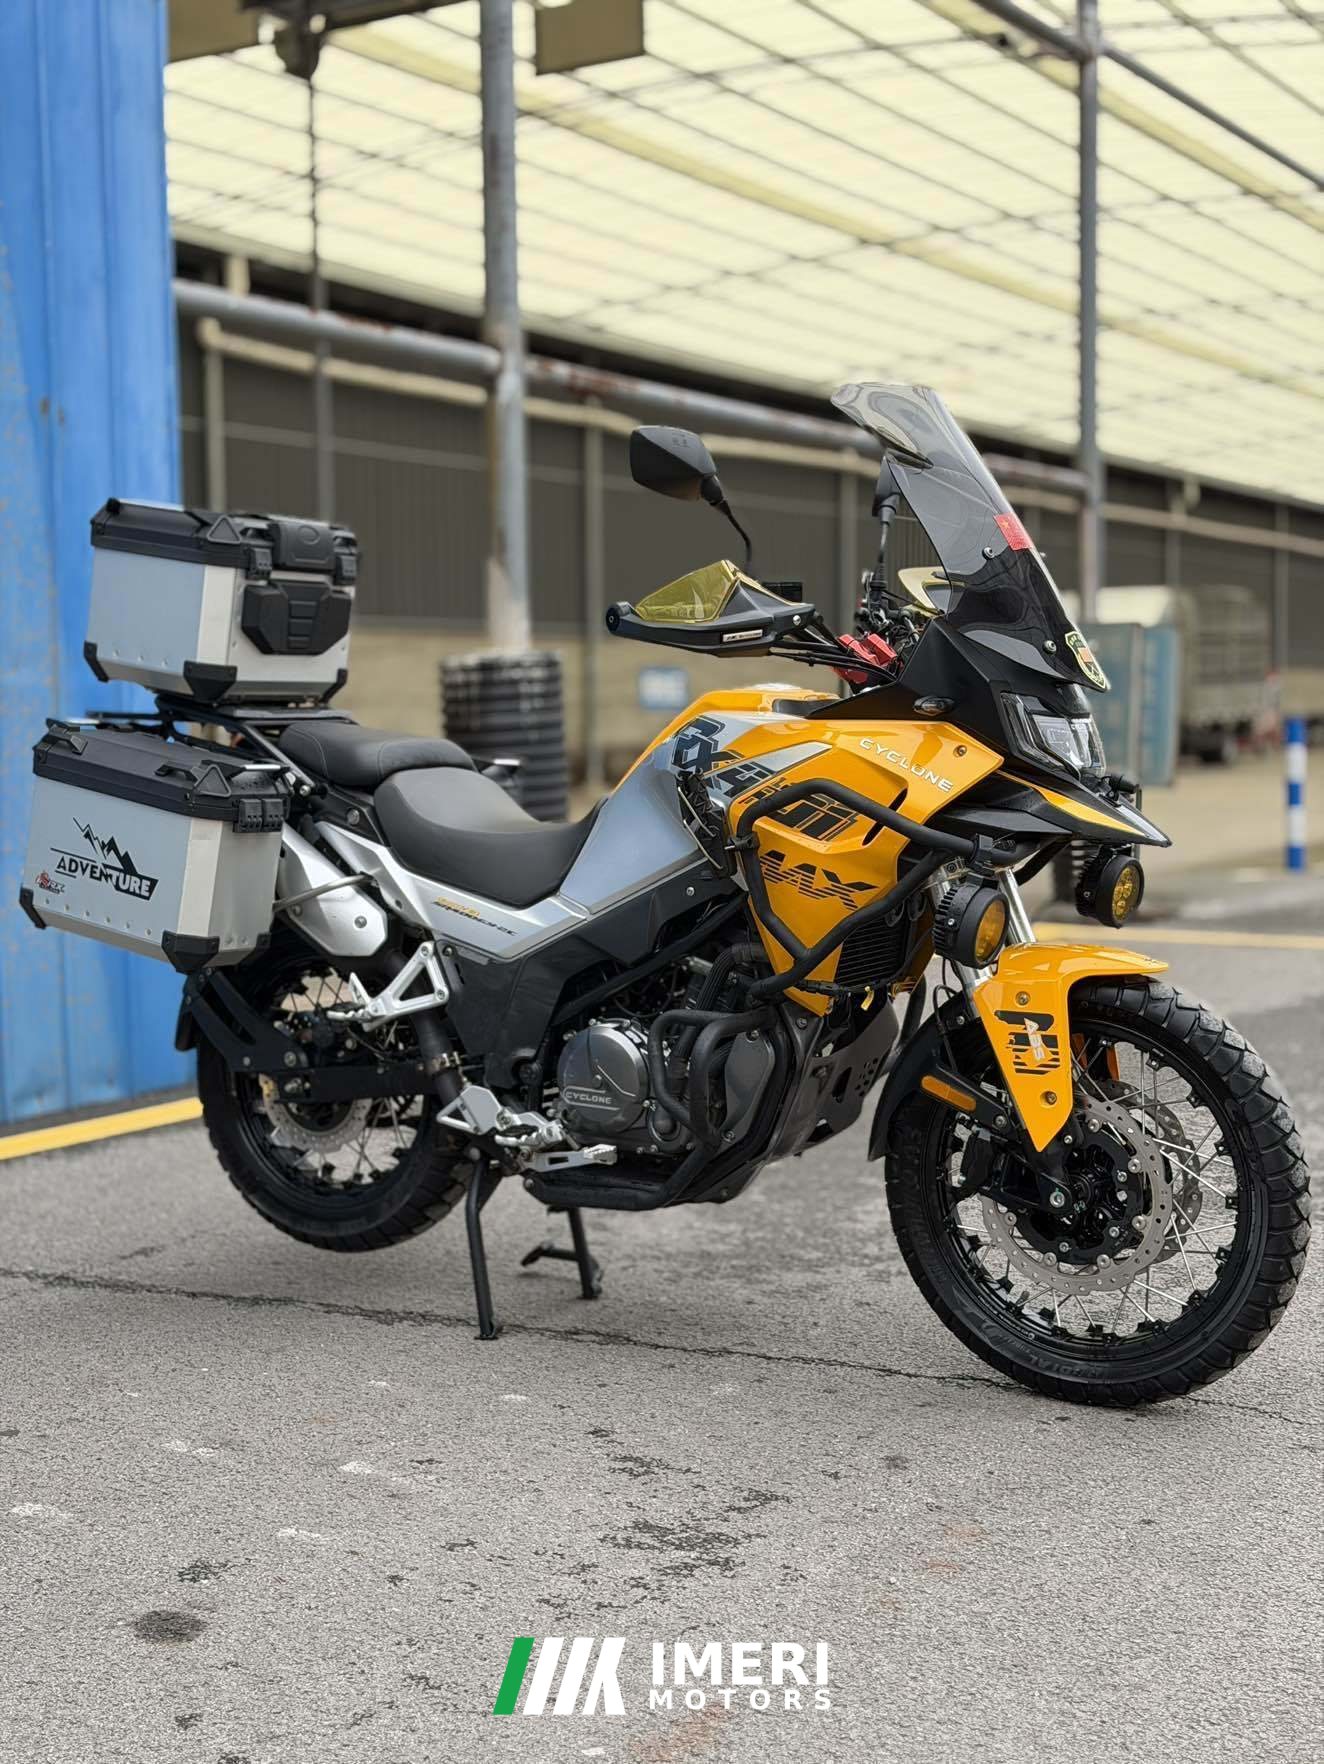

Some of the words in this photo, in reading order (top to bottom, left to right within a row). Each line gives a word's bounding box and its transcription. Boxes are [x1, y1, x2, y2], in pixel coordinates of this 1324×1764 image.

[859, 737, 954, 793] CYCLONE
[56, 855, 152, 897] ADVENTURE
[565, 1091, 613, 1105] CYCLONE
